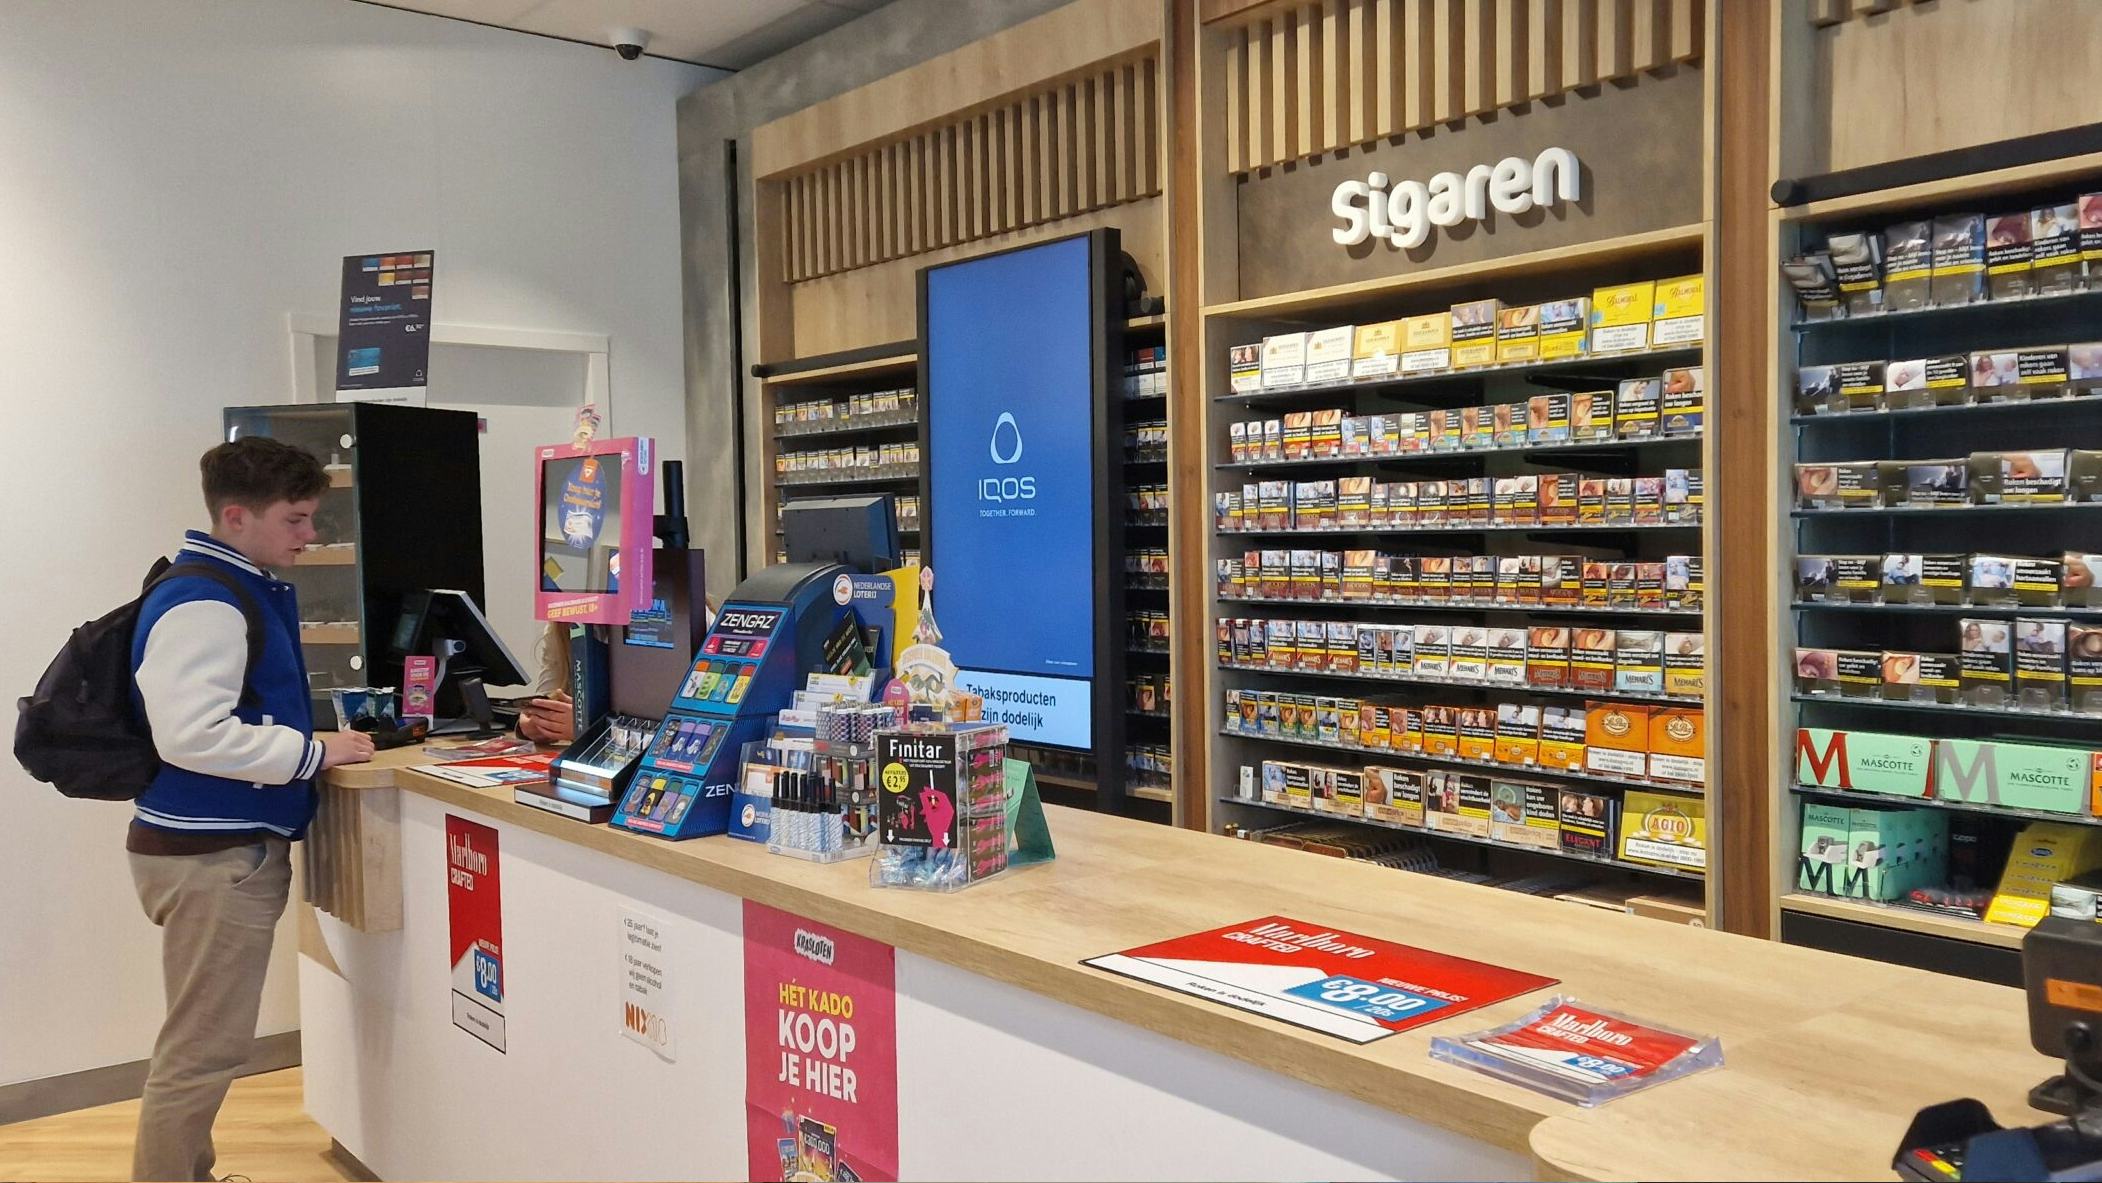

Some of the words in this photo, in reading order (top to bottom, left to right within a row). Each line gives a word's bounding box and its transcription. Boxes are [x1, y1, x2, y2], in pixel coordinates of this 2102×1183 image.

[1331, 146, 1580, 248] Sigaren
[979, 476, 1036, 503] IQOS
[853, 590, 877, 598] LOTERIJ
[720, 613, 775, 628] ZENGAZ
[966, 683, 1057, 707] Tabaksproducten
[981, 709, 999, 724] zijn
[1001, 709, 1044, 730] dodelijk
[889, 738, 942, 759] Finitar
[1797, 729, 1853, 788] M
[1861, 757, 1914, 771] MASCOTTE
[2010, 771, 2070, 786] MASCOTTE
[1651, 817, 1685, 833] AGIO
[449, 832, 487, 876] Marlboro
[450, 867, 474, 891] CRAFTED
[795, 932, 832, 961] KRASLOTEN
[1222, 931, 1302, 953] CRAFTED
[1249, 922, 1376, 959] Marlboro
[779, 978, 805, 1008] HÉT
[808, 987, 853, 1019] KADO
[778, 1008, 856, 1062] KOOP
[1536, 1025, 1590, 1044] CRAFTED
[1551, 1012, 1632, 1046] Marlboro
[778, 1051, 800, 1087] JE
[805, 1057, 857, 1103] HIER
